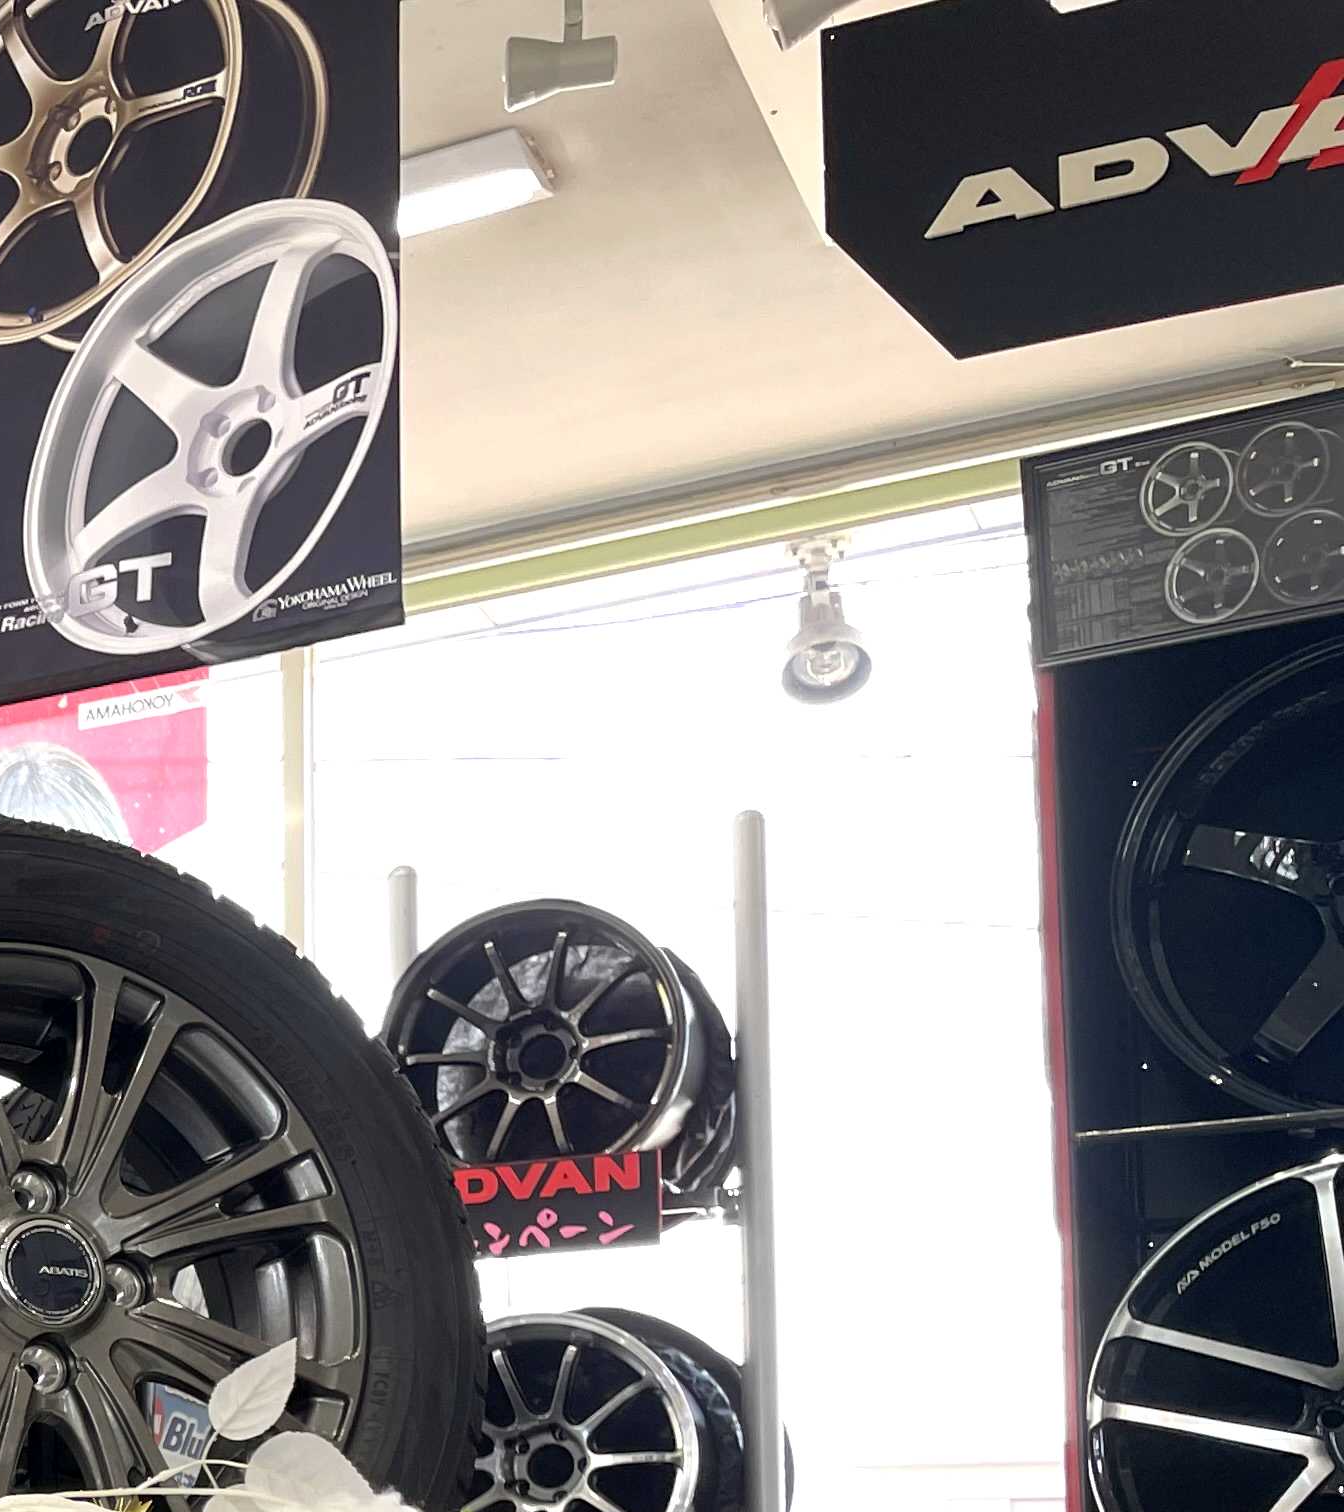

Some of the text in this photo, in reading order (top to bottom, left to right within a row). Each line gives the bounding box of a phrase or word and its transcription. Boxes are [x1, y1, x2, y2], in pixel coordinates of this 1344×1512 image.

[67, 552, 173, 617] GT
[277, 572, 398, 610] YOKOHAMA WHEEL
[454, 1151, 641, 1206] DVAN
[1199, 1230, 1251, 1271] MODEL
[39, 1265, 89, 1279] ABATIS
